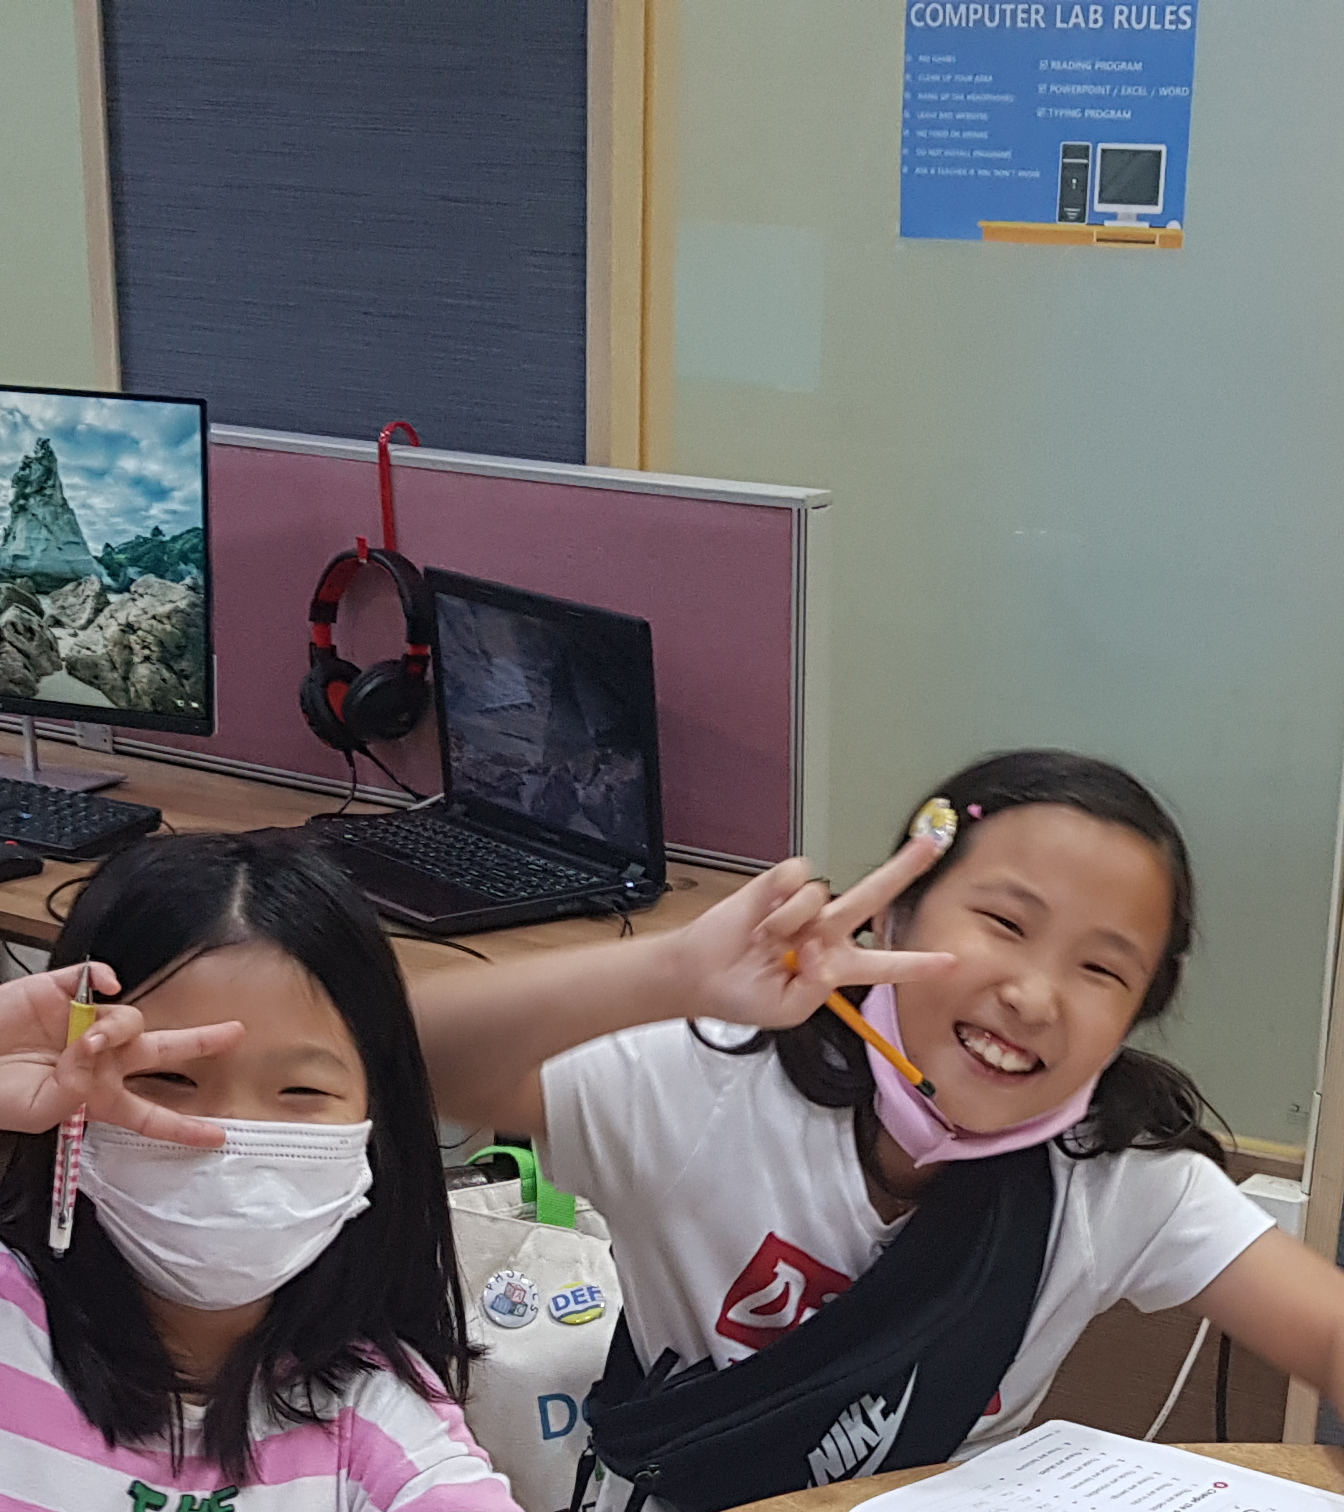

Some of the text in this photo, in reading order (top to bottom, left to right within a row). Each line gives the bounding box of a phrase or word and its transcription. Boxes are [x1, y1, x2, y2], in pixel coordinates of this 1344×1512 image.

[909, 3, 1193, 31] COMPUTER LAB RULES
[1051, 60, 1144, 72] READING PROGRAM
[1158, 86, 1189, 97] WORD
[1048, 108, 1132, 120] TYPING PROGRAM
[551, 1285, 605, 1312] DEF
[807, 1394, 893, 1487] NIKE
